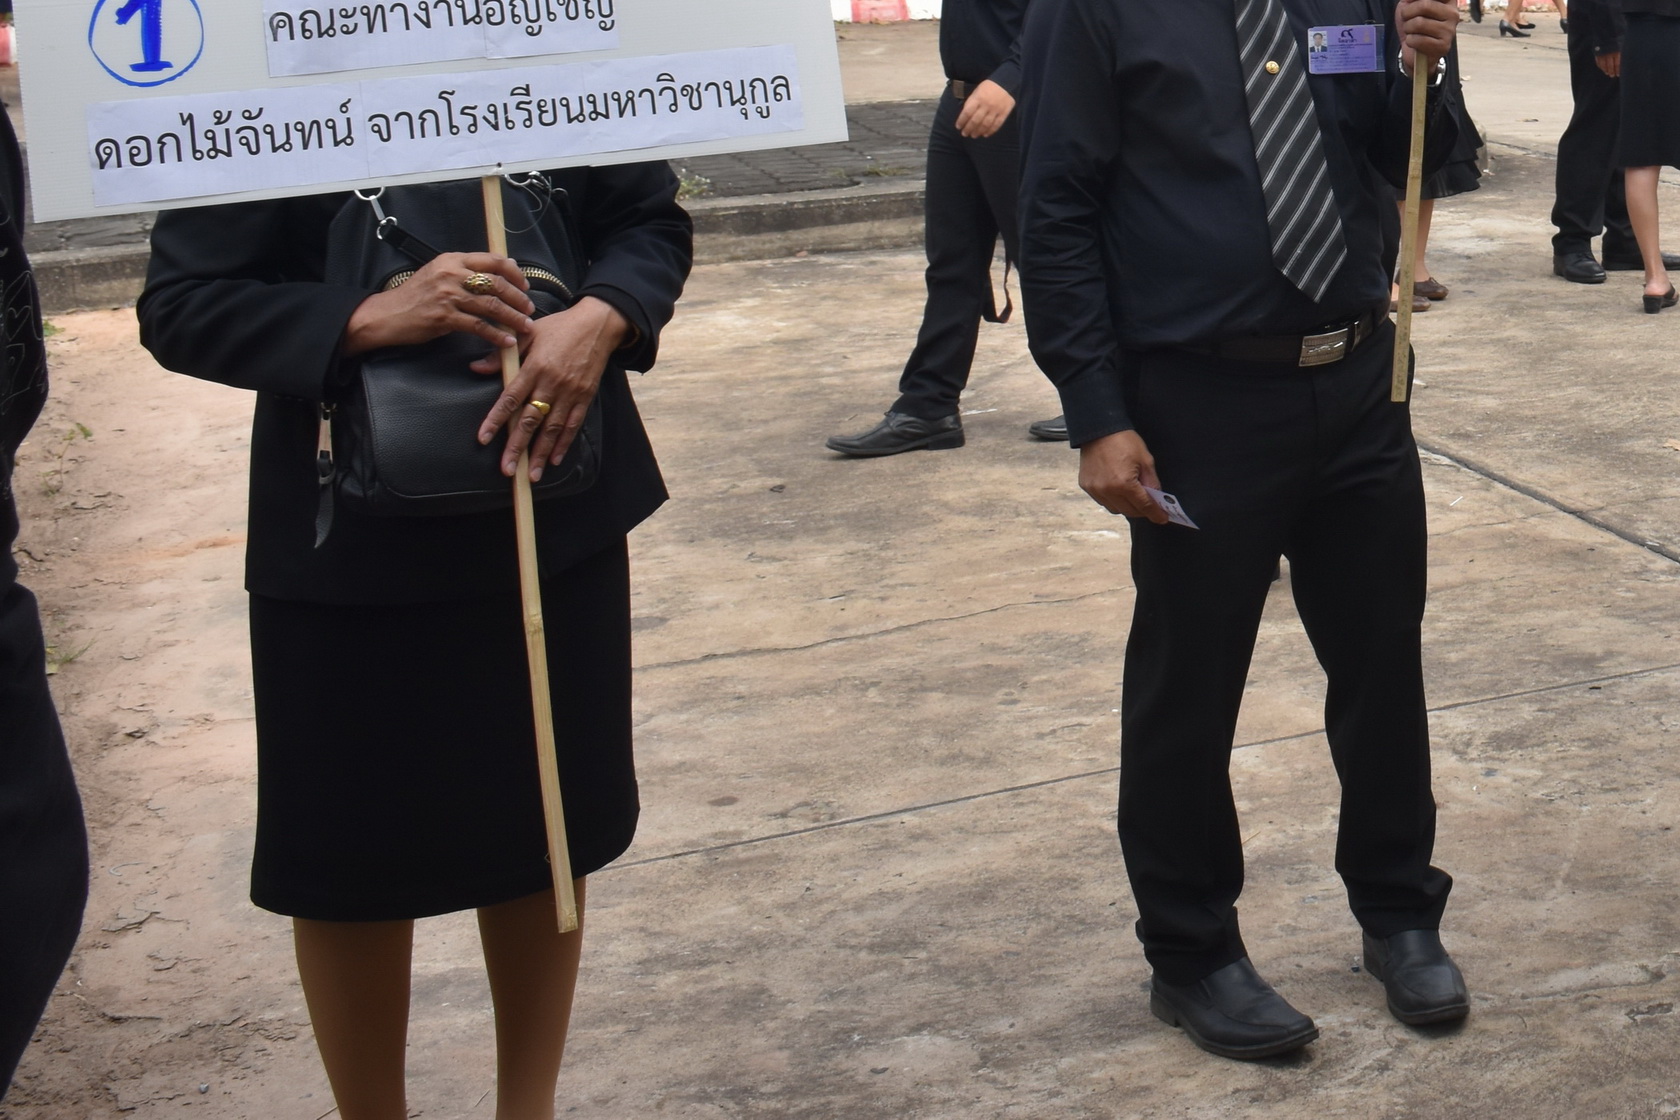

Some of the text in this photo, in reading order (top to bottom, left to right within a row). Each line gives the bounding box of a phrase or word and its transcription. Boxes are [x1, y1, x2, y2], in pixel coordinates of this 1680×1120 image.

[95, 72, 792, 170] ดอกไม้จันทน์ จากโรงเรียนมหาวิชานุกูล
